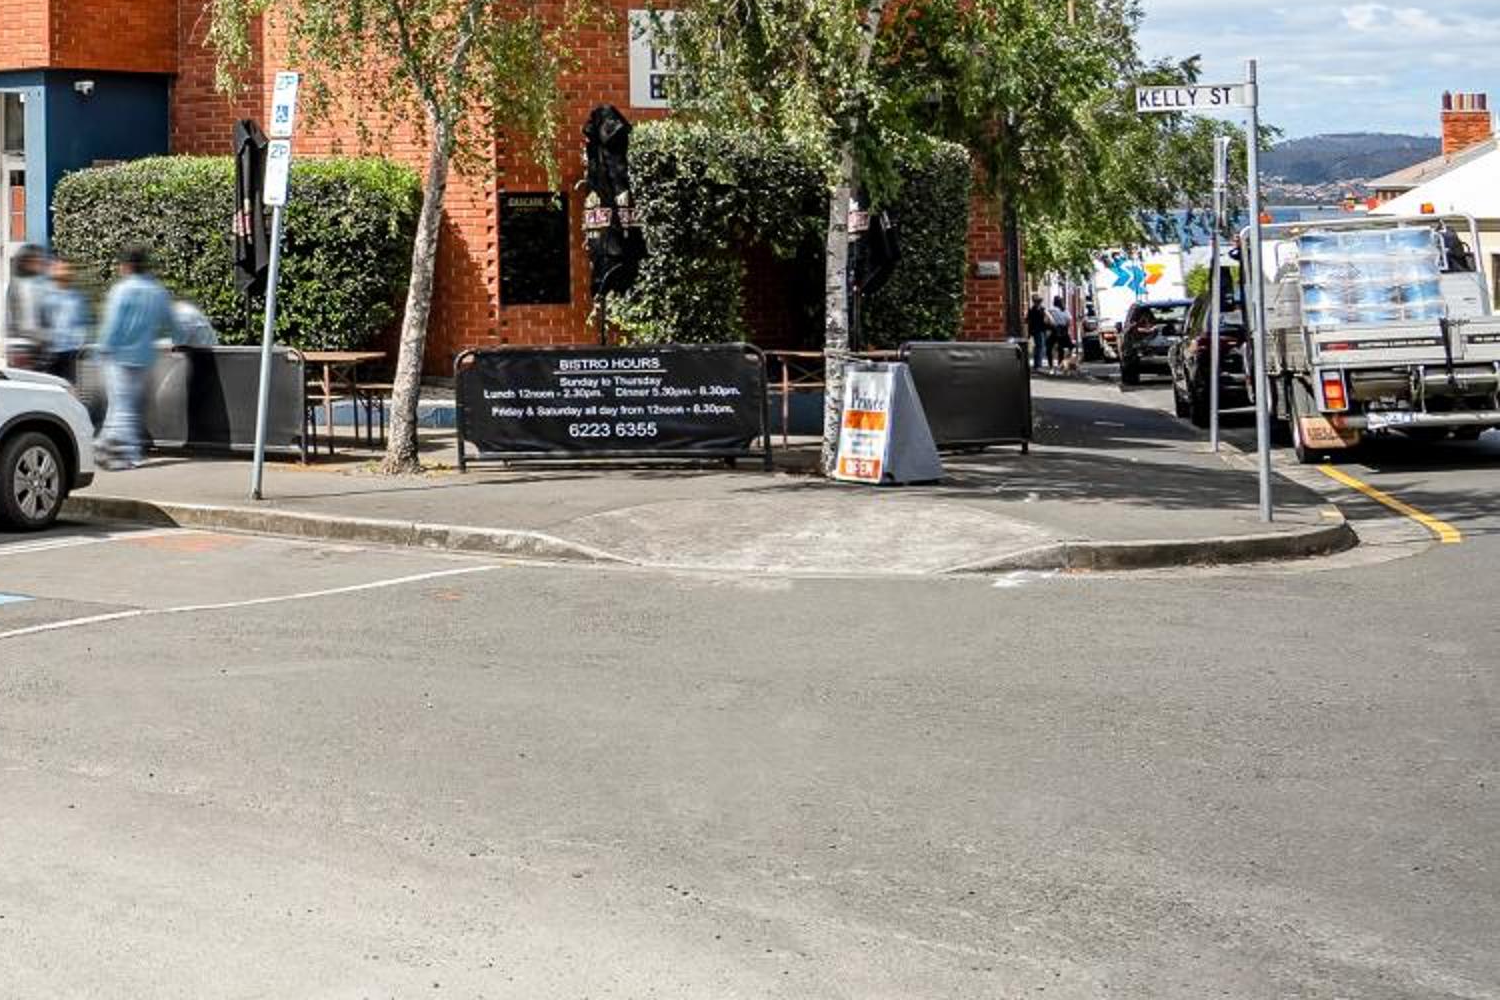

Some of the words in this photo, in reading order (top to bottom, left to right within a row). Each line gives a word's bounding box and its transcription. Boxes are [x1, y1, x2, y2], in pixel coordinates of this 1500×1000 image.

[1139, 88, 1197, 108] KELLY
[1211, 87, 1231, 105] ST
[560, 359, 608, 370] BISTRO
[611, 358, 660, 369] HOURS
[560, 377, 598, 388] Sunday
[601, 377, 611, 386] to
[614, 376, 661, 387] Thursday
[484, 389, 515, 399] Lunch
[519, 388, 554, 398] 12noon
[615, 387, 649, 397] Dinner
[492, 406, 524, 418] Friday
[537, 405, 581, 417] Saturday
[585, 405, 596, 415] all
[599, 405, 617, 417] day
[620, 404, 644, 415] from
[647, 404, 684, 415] 12noon
[568, 423, 611, 437] 6223
[615, 422, 658, 437] 6355
